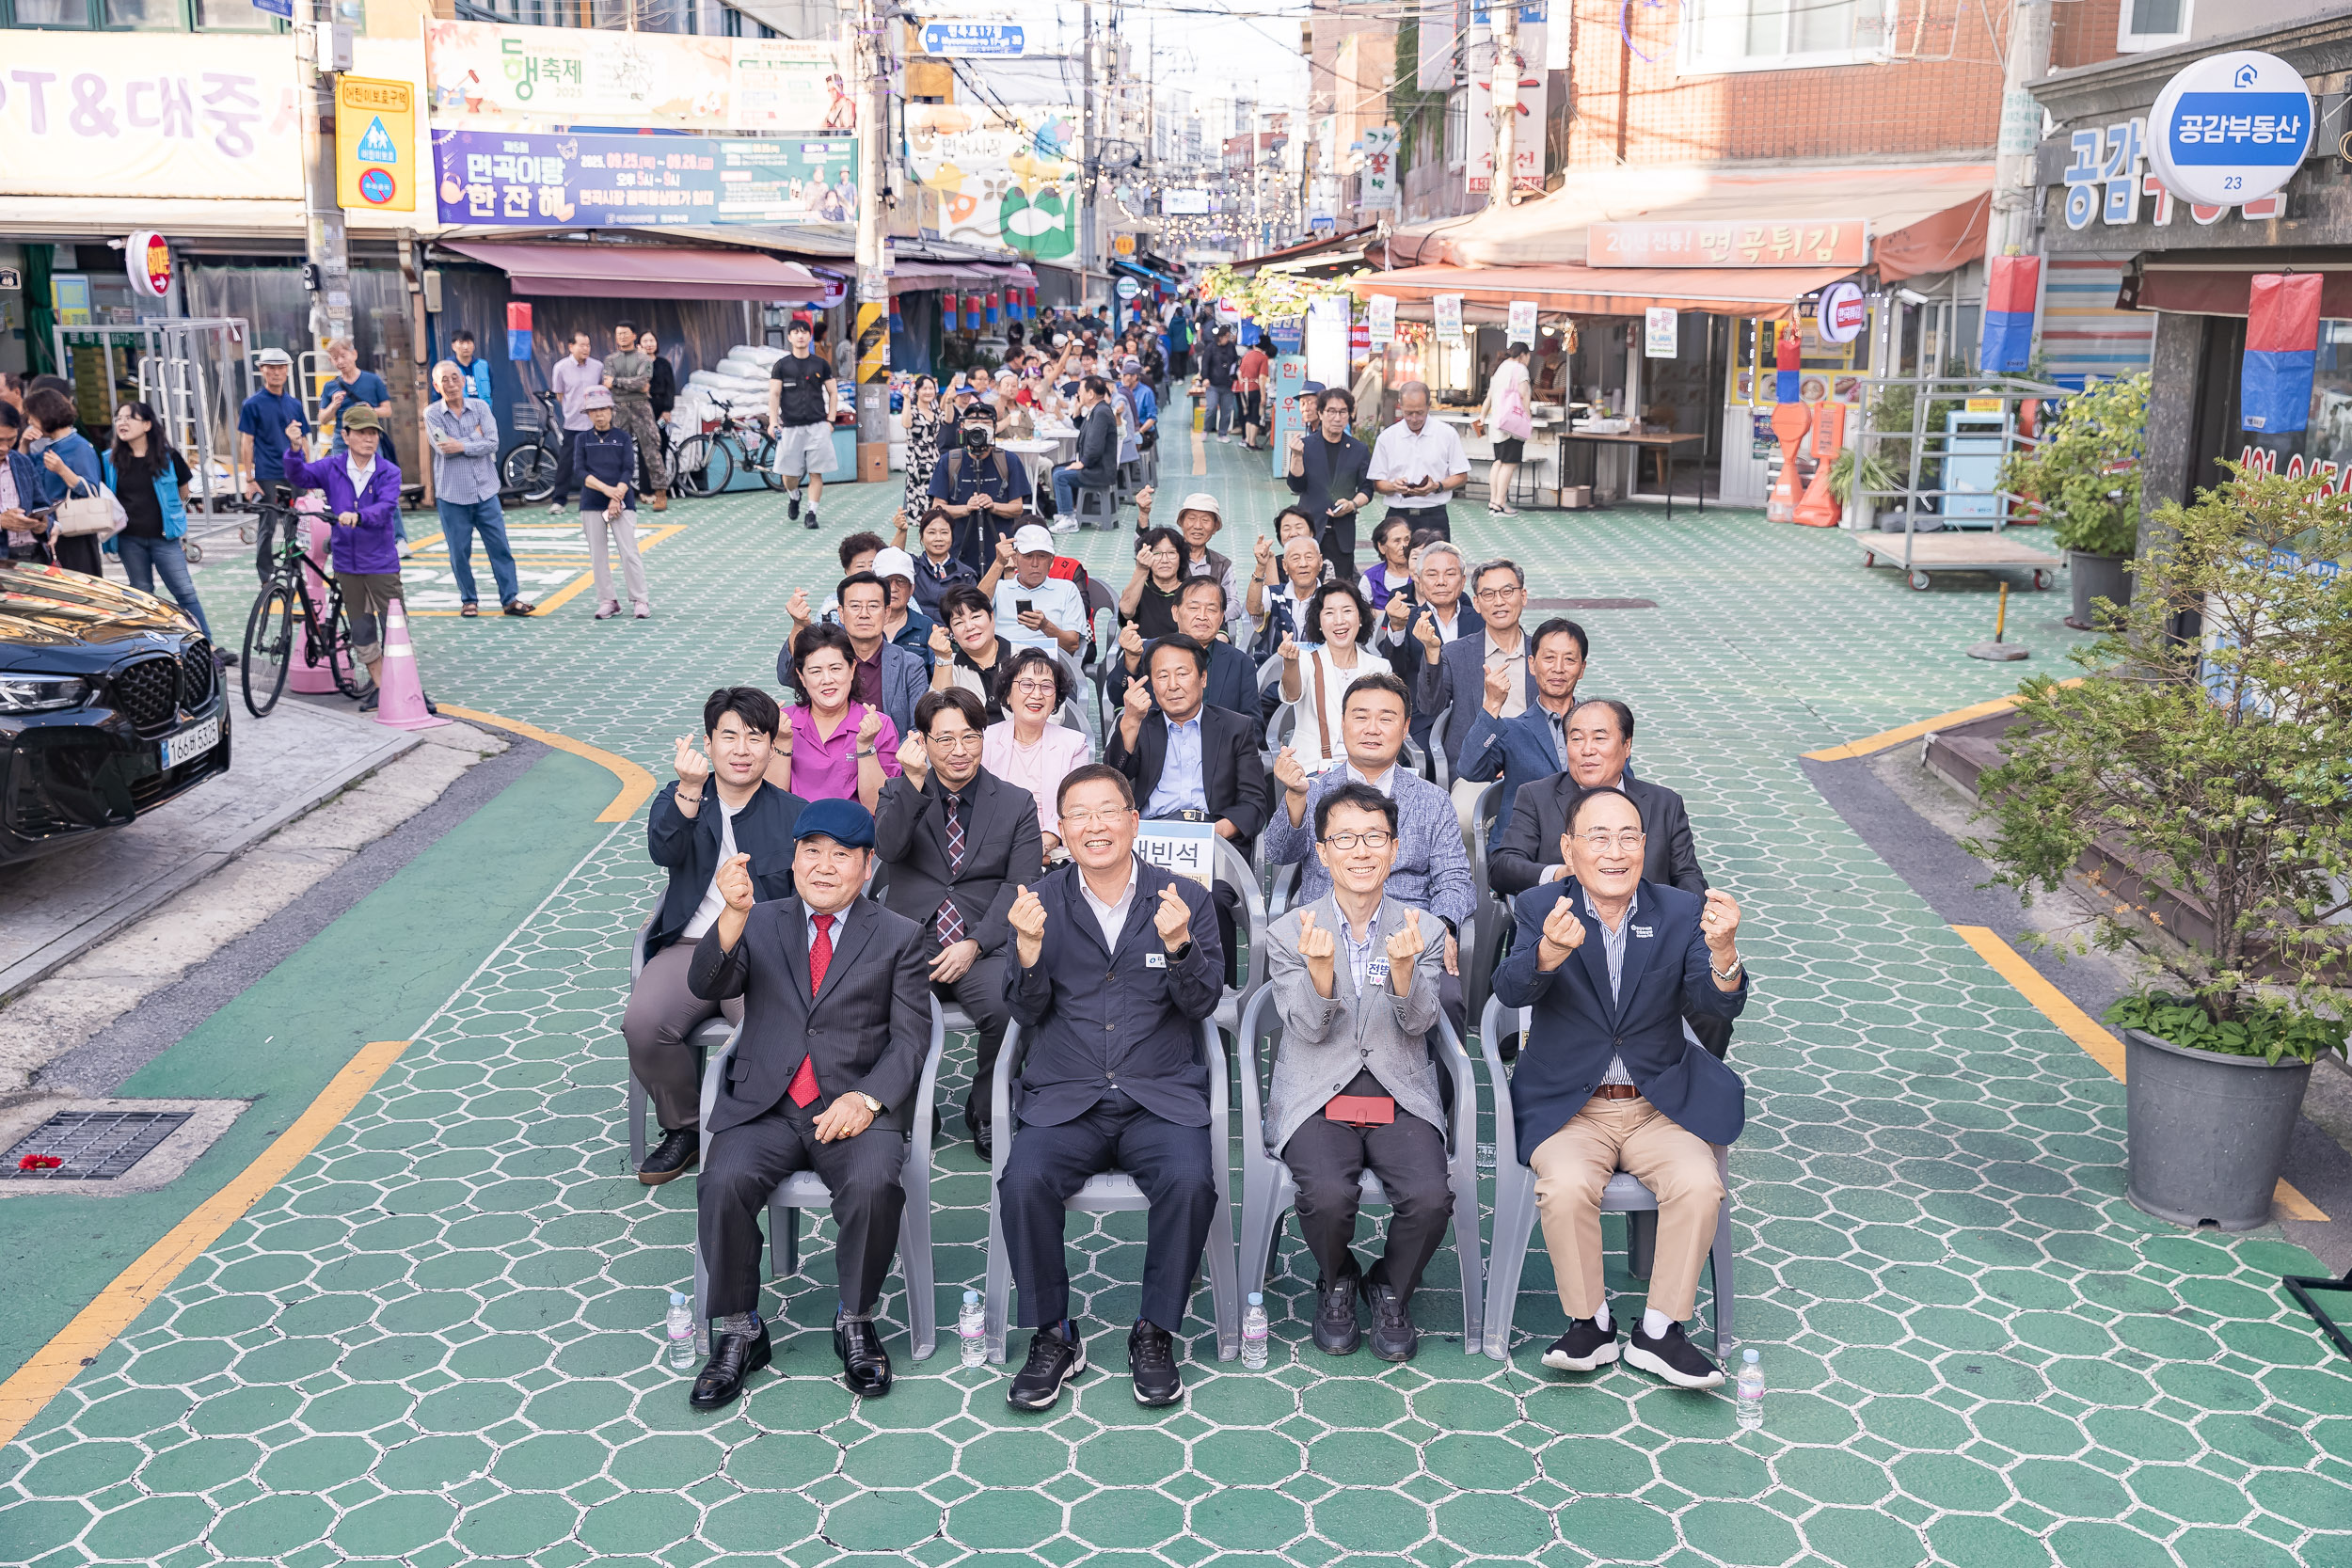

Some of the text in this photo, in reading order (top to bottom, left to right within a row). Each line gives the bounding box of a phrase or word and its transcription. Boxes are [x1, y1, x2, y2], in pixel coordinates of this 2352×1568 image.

[2179, 115, 2301, 144] 공감부동산
[467, 153, 565, 185] 면곡이랑
[2224, 176, 2243, 190] 23
[468, 183, 498, 217] 한
[503, 185, 532, 217] 잔
[1699, 225, 1840, 262] 면곡튀김
